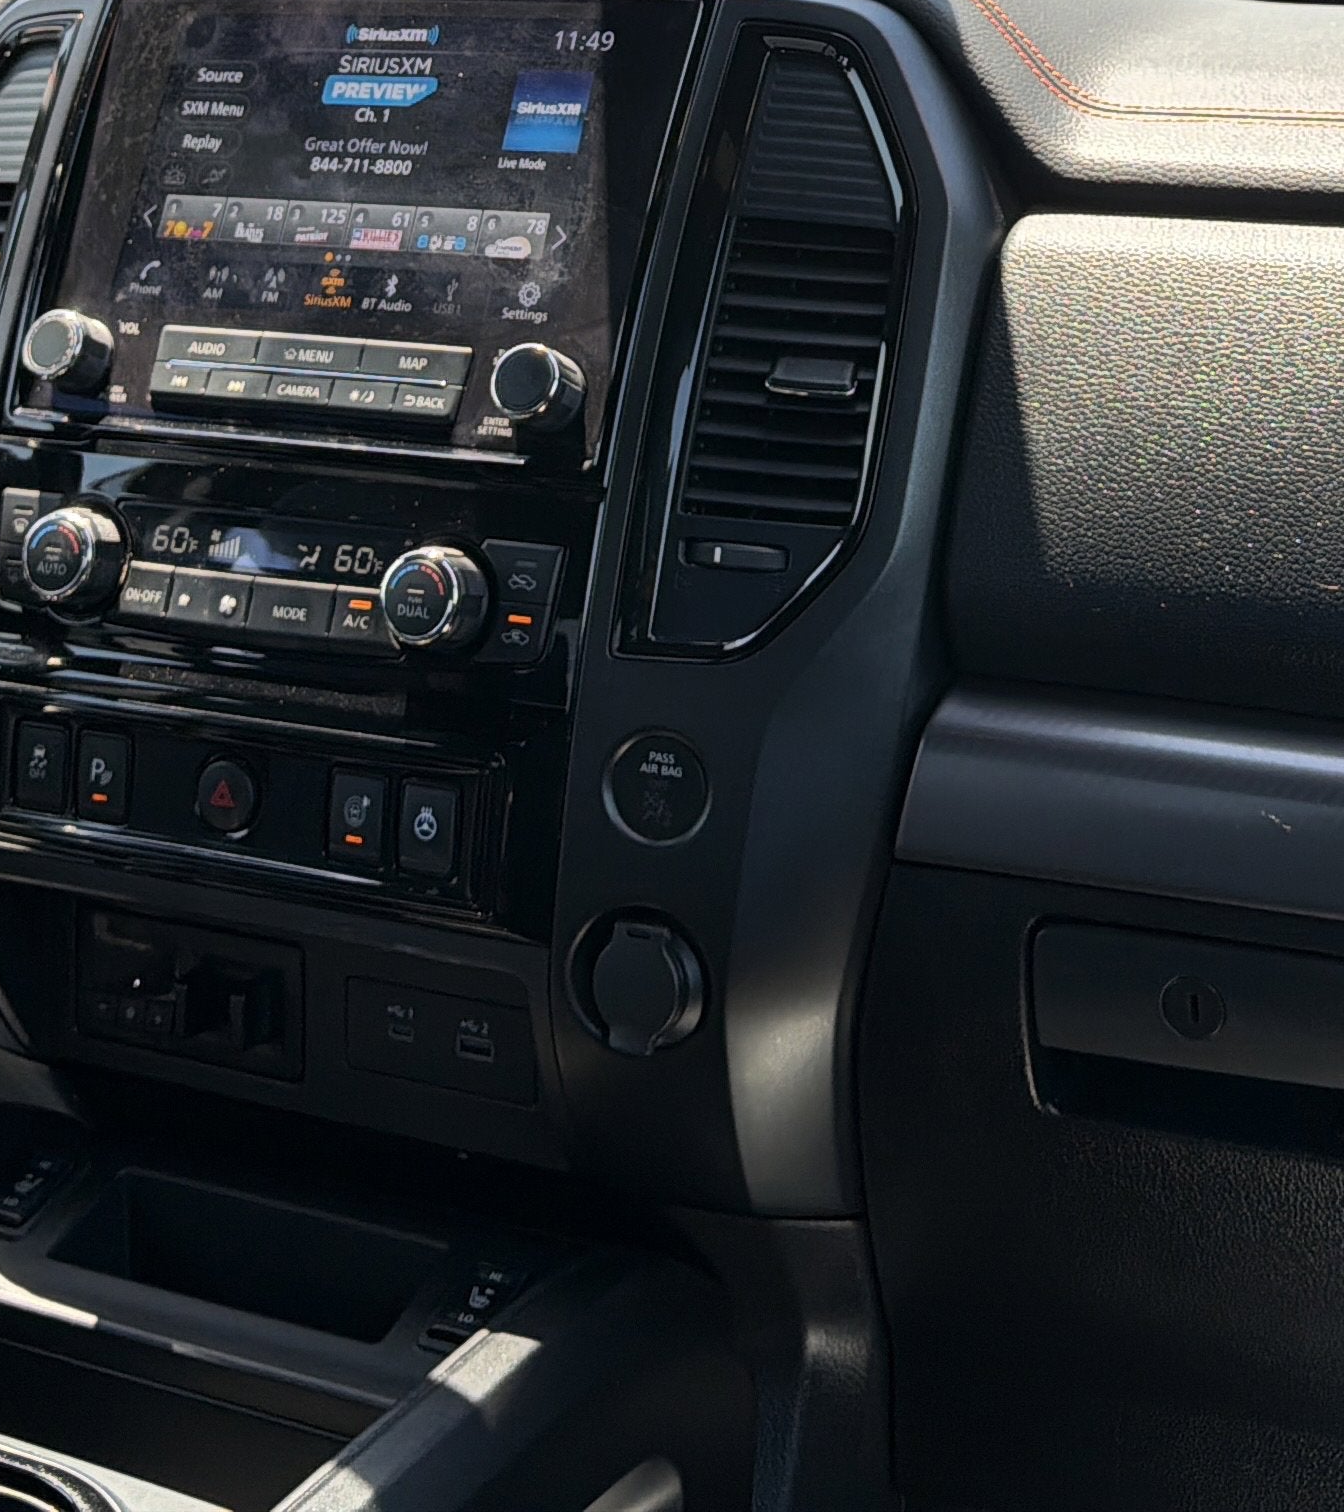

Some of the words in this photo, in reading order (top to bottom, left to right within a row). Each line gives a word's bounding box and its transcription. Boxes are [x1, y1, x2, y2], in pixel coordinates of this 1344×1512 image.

[555, 30, 615, 52] 11:49
[197, 67, 244, 84] Source
[331, 82, 429, 100] PREVIEW
[181, 100, 209, 117] SXM
[210, 101, 245, 118] Menu
[354, 108, 378, 123] Ch.
[382, 108, 391, 123] 1
[182, 134, 223, 153] Replay
[304, 136, 344, 153] Great
[347, 137, 386, 155] Offer
[388, 140, 428, 156] Now!
[309, 156, 413, 176] 844-711-8800
[497, 157, 516, 170] Live
[517, 158, 547, 171] Mode
[212, 203, 223, 218] 7
[229, 205, 239, 218] 2
[266, 205, 284, 221] 18
[320, 208, 348, 225] 125
[355, 212, 365, 224] 4
[391, 211, 410, 228] 61
[420, 215, 430, 228] 5
[466, 215, 479, 232] 8
[487, 218, 497, 231] 6
[526, 219, 547, 235] 78
[128, 282, 162, 296] Phone
[203, 288, 224, 300] AM
[261, 290, 279, 303] FM
[304, 293, 352, 308] SiriusXM
[361, 297, 375, 310] BT
[377, 298, 413, 313] Audio
[502, 307, 549, 325] Settings
[117, 321, 141, 336] VOL
[187, 341, 226, 357] AUDIO
[297, 349, 335, 364] MENU
[398, 356, 428, 371] MAP
[276, 384, 321, 399] CAMERA
[415, 396, 446, 410] BACK
[482, 415, 510, 427] ENTER
[477, 425, 513, 438] SETTING
[36, 561, 68, 576] AUTO
[272, 604, 308, 622] MODE
[396, 603, 430, 619] DUAL
[342, 614, 371, 630] A/C
[648, 750, 676, 765] PASS
[639, 761, 658, 775] AIR
[660, 765, 684, 779] BAG
